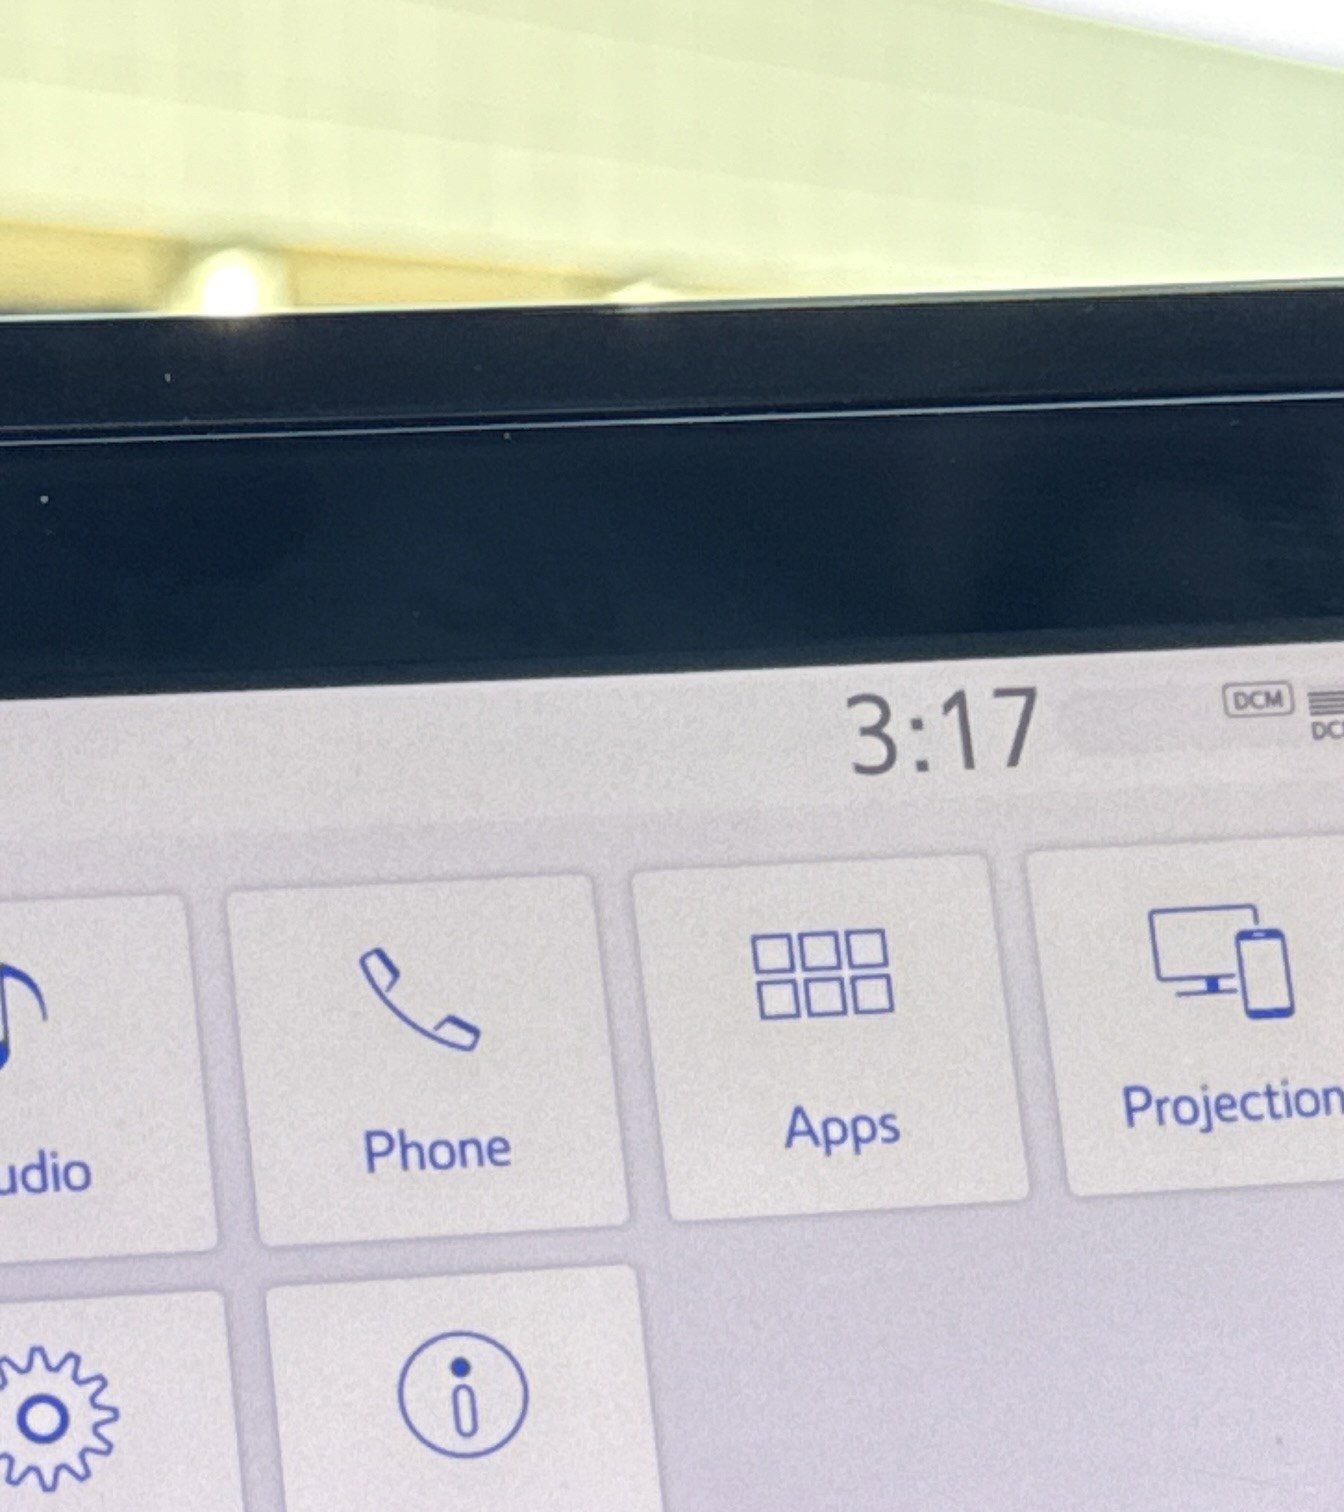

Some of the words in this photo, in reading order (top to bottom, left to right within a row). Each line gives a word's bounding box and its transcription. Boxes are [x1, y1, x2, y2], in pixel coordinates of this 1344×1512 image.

[1233, 690, 1284, 711] DCM
[847, 686, 1038, 776] 3:17
[364, 1129, 512, 1173] Phone
[784, 1105, 901, 1156] Apps
